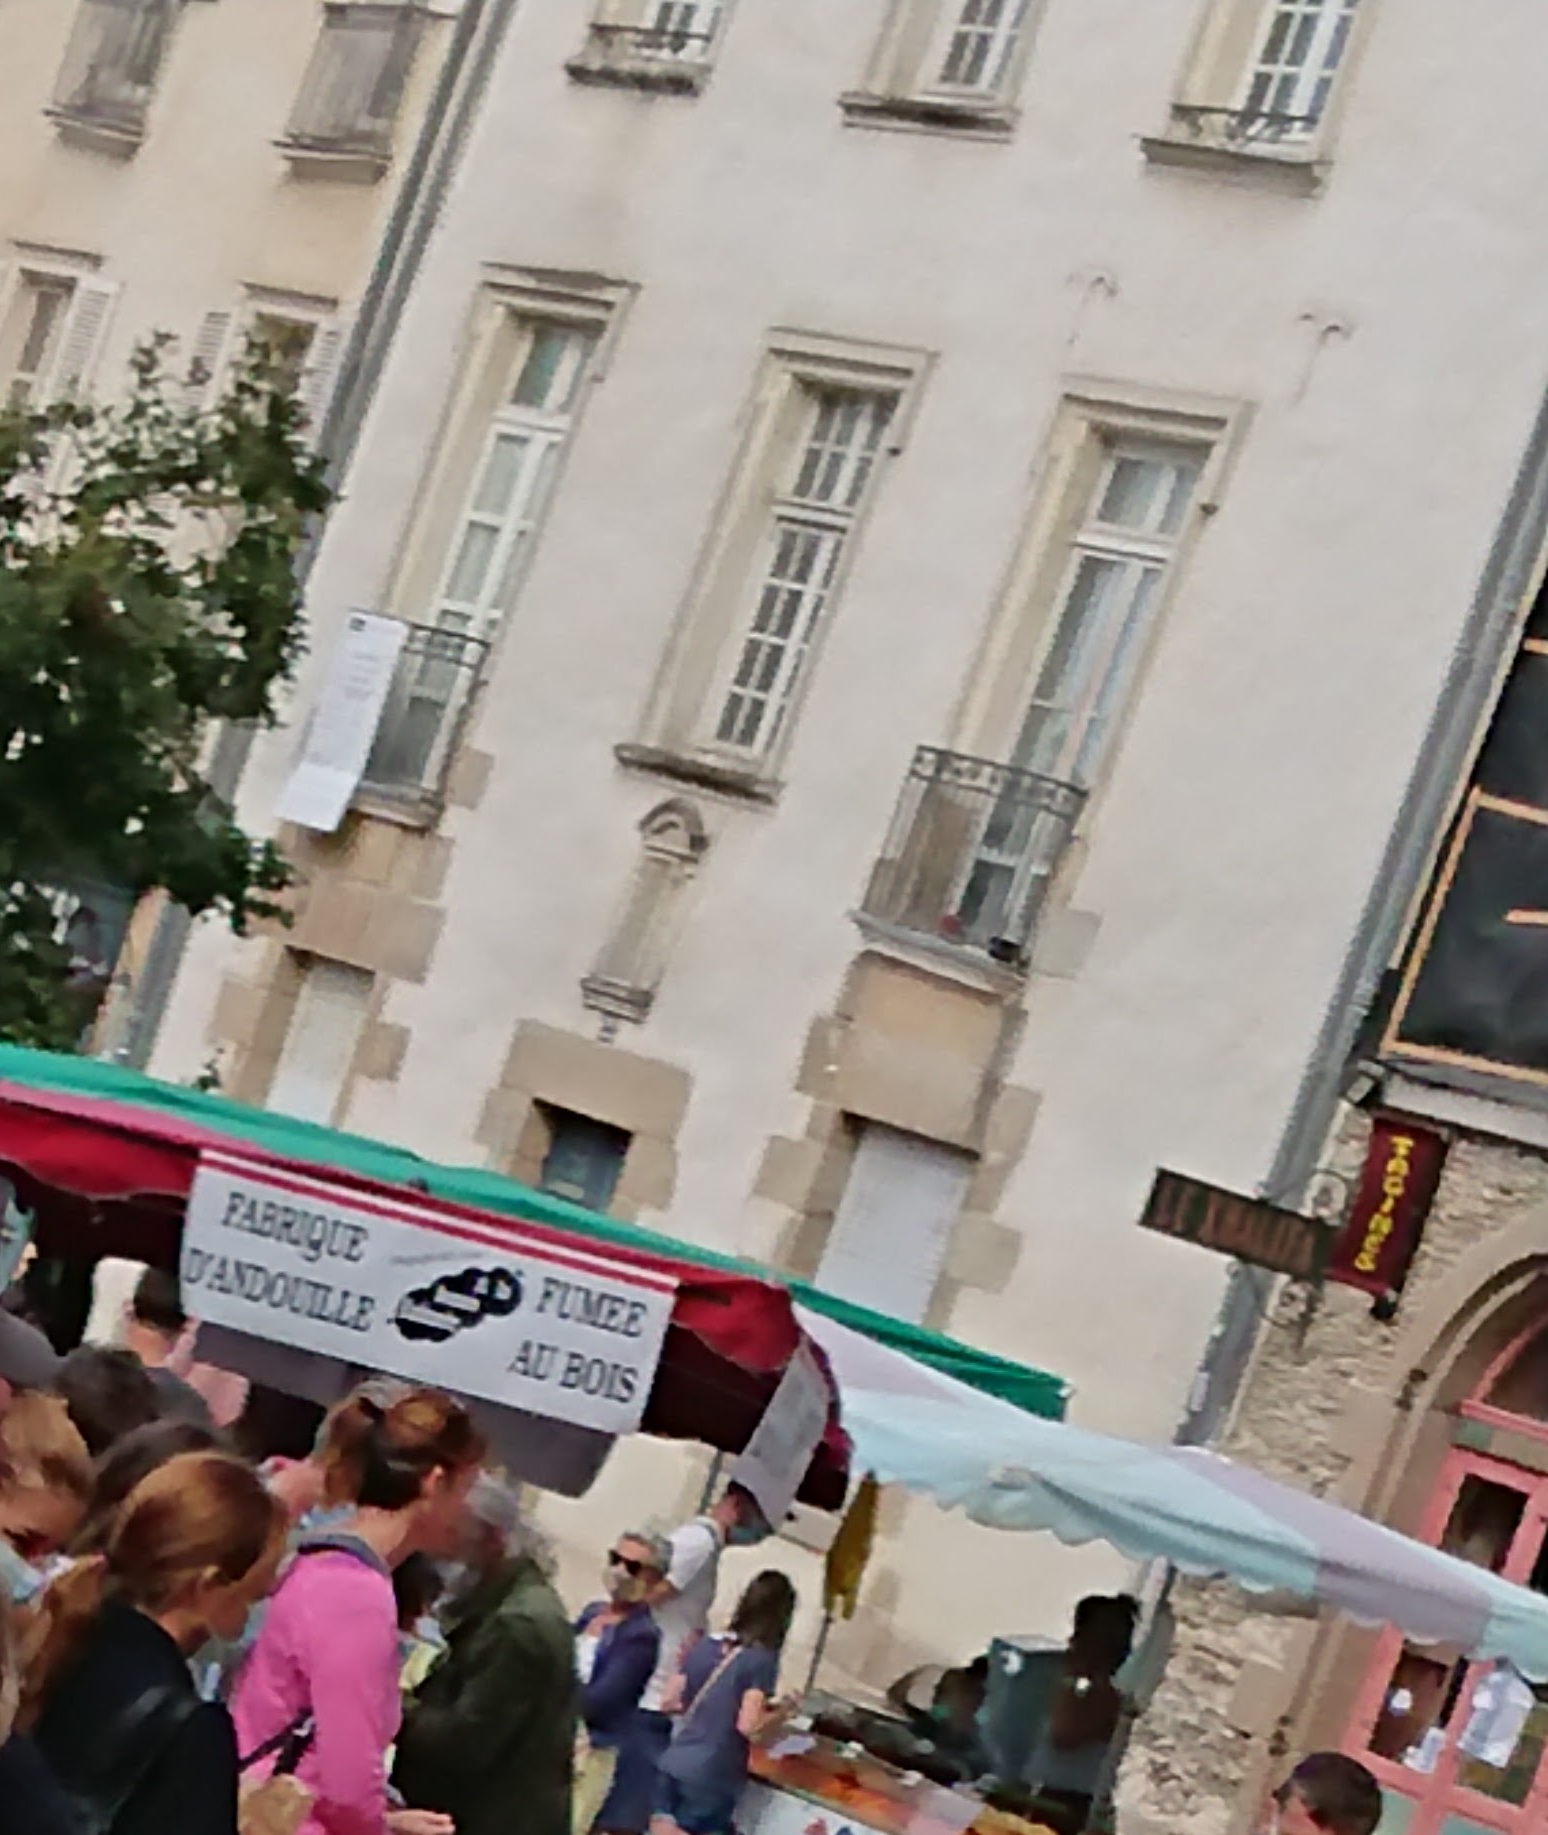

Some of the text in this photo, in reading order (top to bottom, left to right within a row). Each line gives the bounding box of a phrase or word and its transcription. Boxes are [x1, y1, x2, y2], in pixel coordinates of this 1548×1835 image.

[221, 1191, 369, 1262] FABRIQUE
[183, 1247, 375, 1332] D'ANDOUILLE
[536, 1276, 647, 1337] FUMEE
[506, 1340, 639, 1403] AU BOIS
